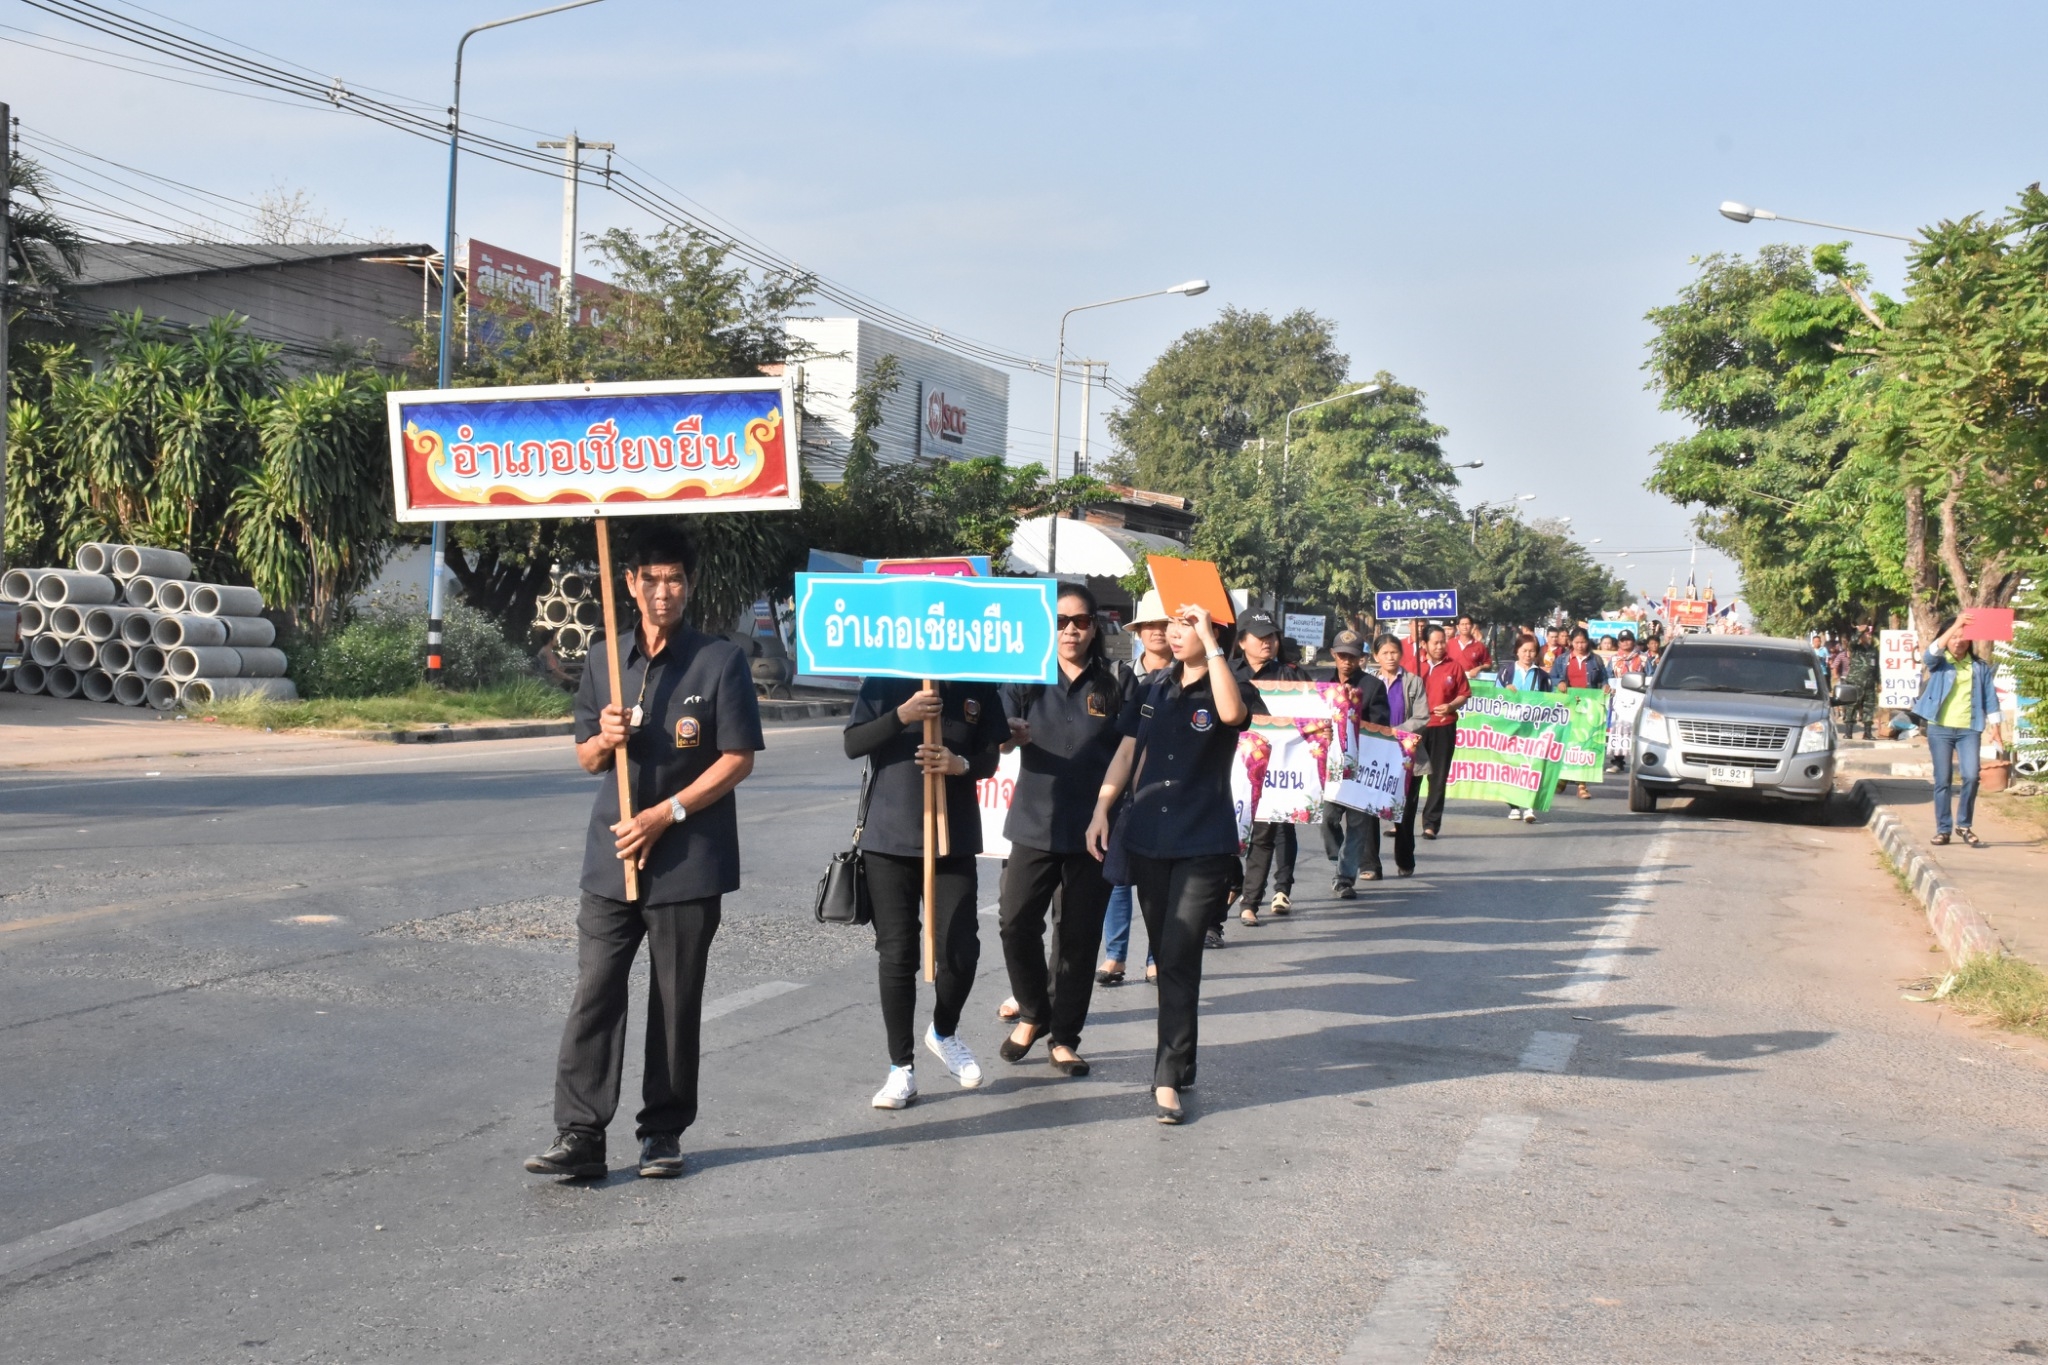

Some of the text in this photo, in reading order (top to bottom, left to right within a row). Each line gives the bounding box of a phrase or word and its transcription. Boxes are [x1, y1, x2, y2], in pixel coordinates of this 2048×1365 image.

[450, 415, 738, 477] อำเภอเชียงยืน
[1382, 593, 1452, 615] อำเภอกุดรัง
[825, 598, 1025, 655] อำเภอเชียงยืน
[1886, 633, 1919, 653] บริ
[1564, 746, 1595, 765] เพียง
[1264, 770, 1305, 790] มชน
[1730, 768, 1746, 779] 921
